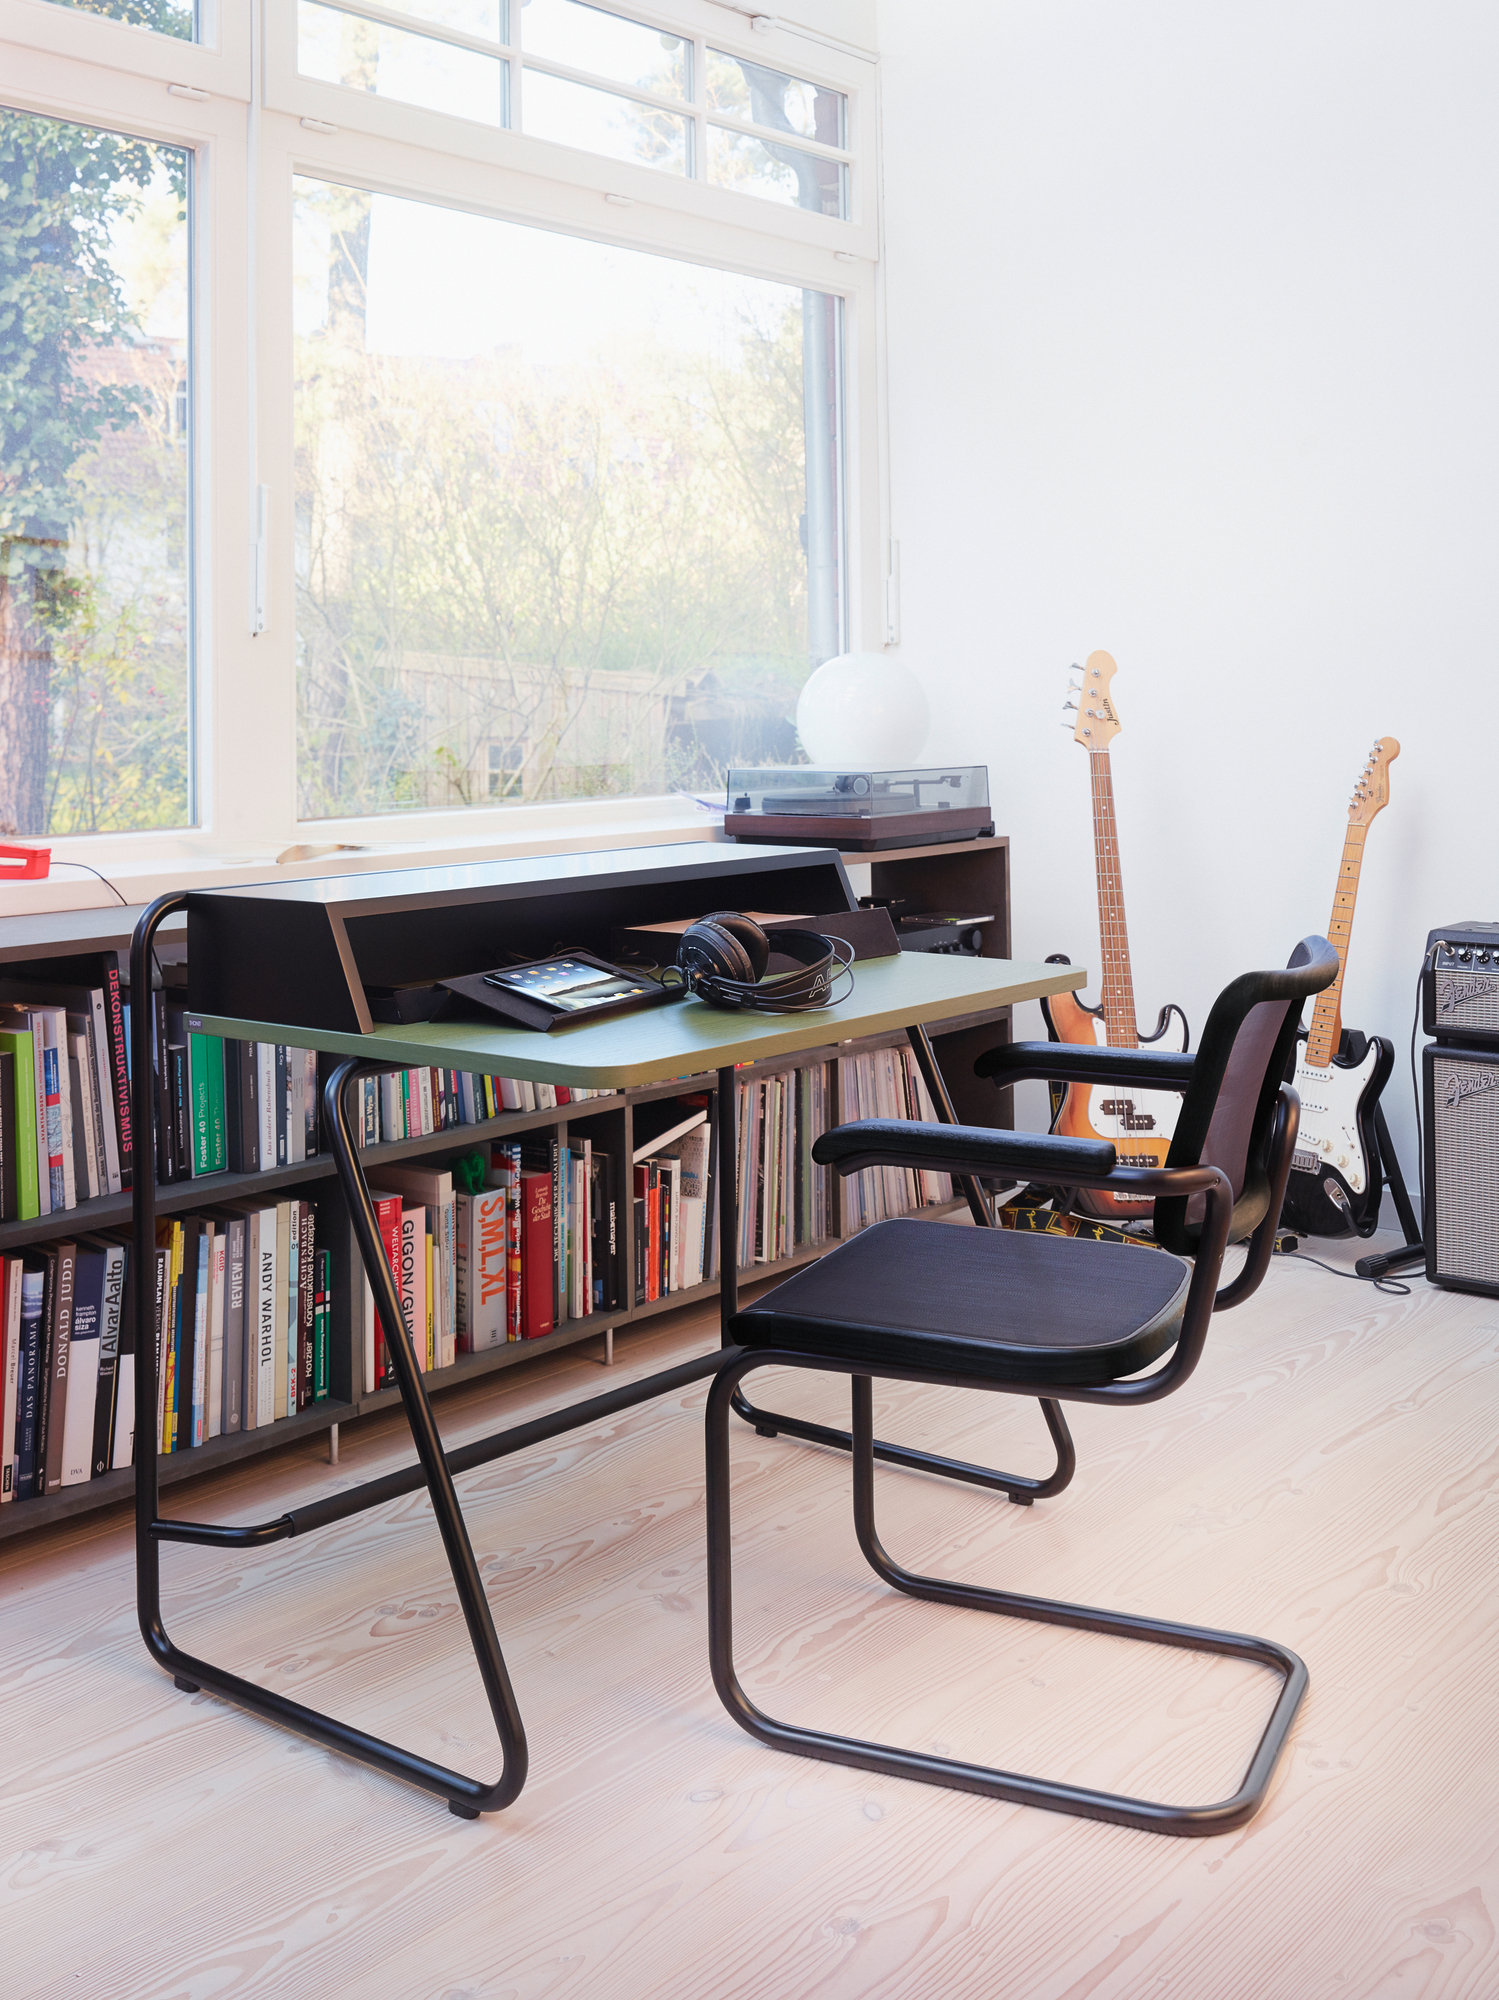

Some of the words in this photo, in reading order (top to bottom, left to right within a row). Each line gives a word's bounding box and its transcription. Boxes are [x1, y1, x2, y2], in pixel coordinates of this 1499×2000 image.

[1103, 698, 1119, 725] Justin
[1438, 976, 1497, 1013] Fender
[86, 1020, 95, 1057] Deutschland
[90, 1058, 99, 1103] Bundesrepublik
[108, 969, 132, 1153] DEKONSTRUKTIVISMUS
[197, 1082, 207, 1119] Projects
[264, 1070, 272, 1113] Rubensbuch
[366, 1095, 374, 1115] Wyss
[1444, 1071, 1499, 1107] Fender
[95, 1113, 103, 1147] Demokratie
[199, 1121, 206, 1134] 40
[214, 1118, 221, 1130] 40
[199, 1136, 207, 1168] Foster
[214, 1133, 222, 1165] Foster
[538, 1197, 547, 1206] Die
[299, 1217, 308, 1289] ACHENBACH
[306, 1214, 316, 1262] Konzepte
[478, 1195, 506, 1306] S,M,L,XL
[61, 1258, 72, 1302] JUDD
[105, 1259, 123, 1305] Aalto
[156, 1257, 164, 1304] RAUMPLAN
[231, 1262, 243, 1309] REVIEW
[262, 1252, 273, 1292] ANDY
[306, 1264, 314, 1327] Konstruktive
[56, 1309, 70, 1379] DONALD
[101, 1308, 119, 1353] Alvar
[261, 1298, 272, 1367] WARHOL
[28, 1322, 37, 1390] PANORAMA
[25, 1395, 34, 1418] DAS
[70, 1467, 83, 1476] DVA
